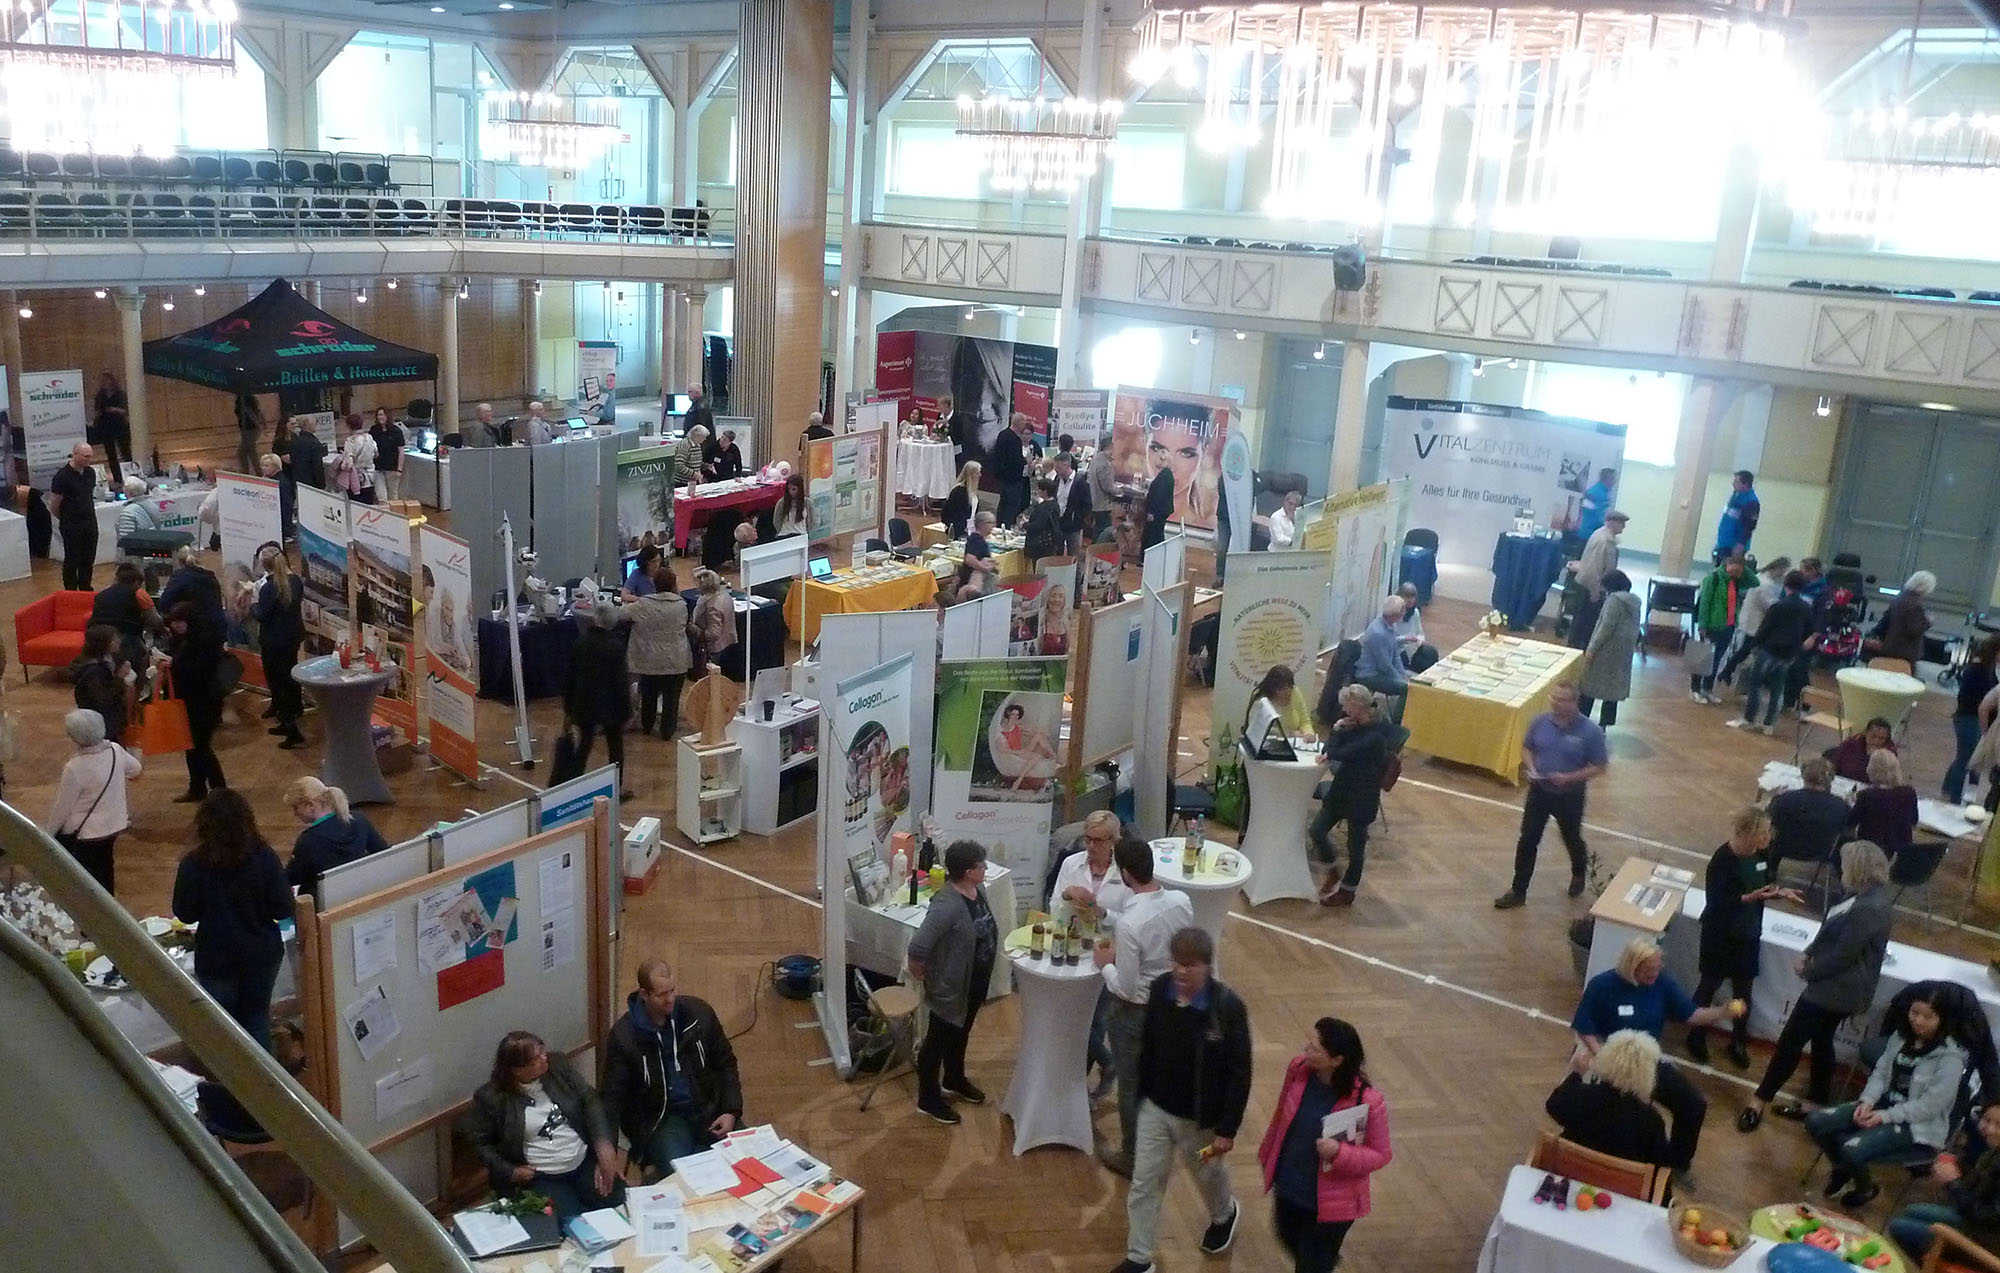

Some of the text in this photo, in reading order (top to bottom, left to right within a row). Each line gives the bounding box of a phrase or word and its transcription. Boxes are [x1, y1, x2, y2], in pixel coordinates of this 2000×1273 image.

[333, 366, 344, 380] &
[1127, 410, 1220, 439] JUCHHEIM
[628, 462, 666, 478] ZINZINO
[1421, 484, 1444, 497] Alles
[1462, 487, 1479, 500] Ihre
[1482, 490, 1532, 508] Gesundheit
[848, 691, 882, 714] Cellagon
[955, 811, 996, 820] Cellagon
